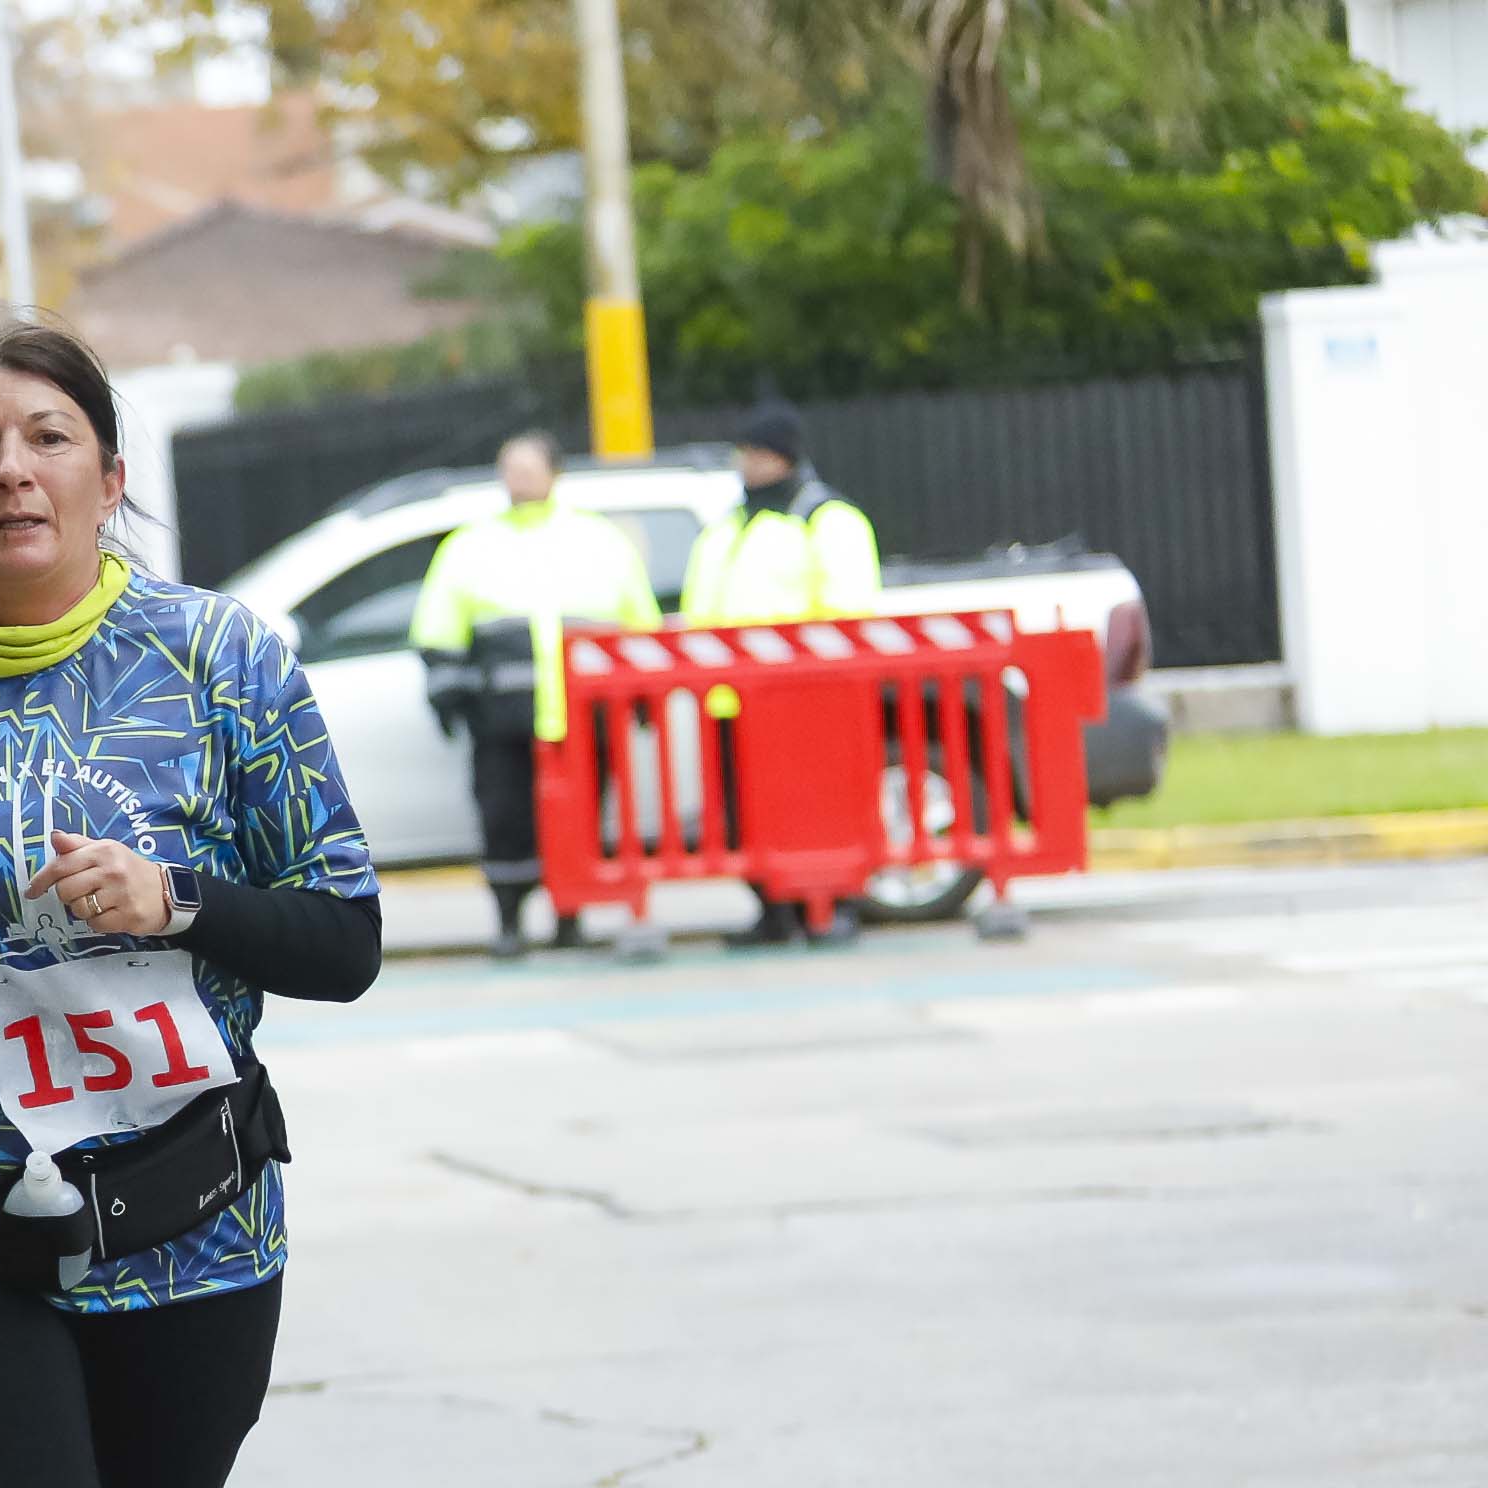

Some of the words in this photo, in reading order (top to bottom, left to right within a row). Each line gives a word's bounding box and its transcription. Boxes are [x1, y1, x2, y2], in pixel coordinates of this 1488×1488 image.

[16, 760, 34, 779] X
[41, 758, 67, 778] EL
[72, 764, 157, 855] AUTISMO
[3, 1000, 210, 1109] 151
